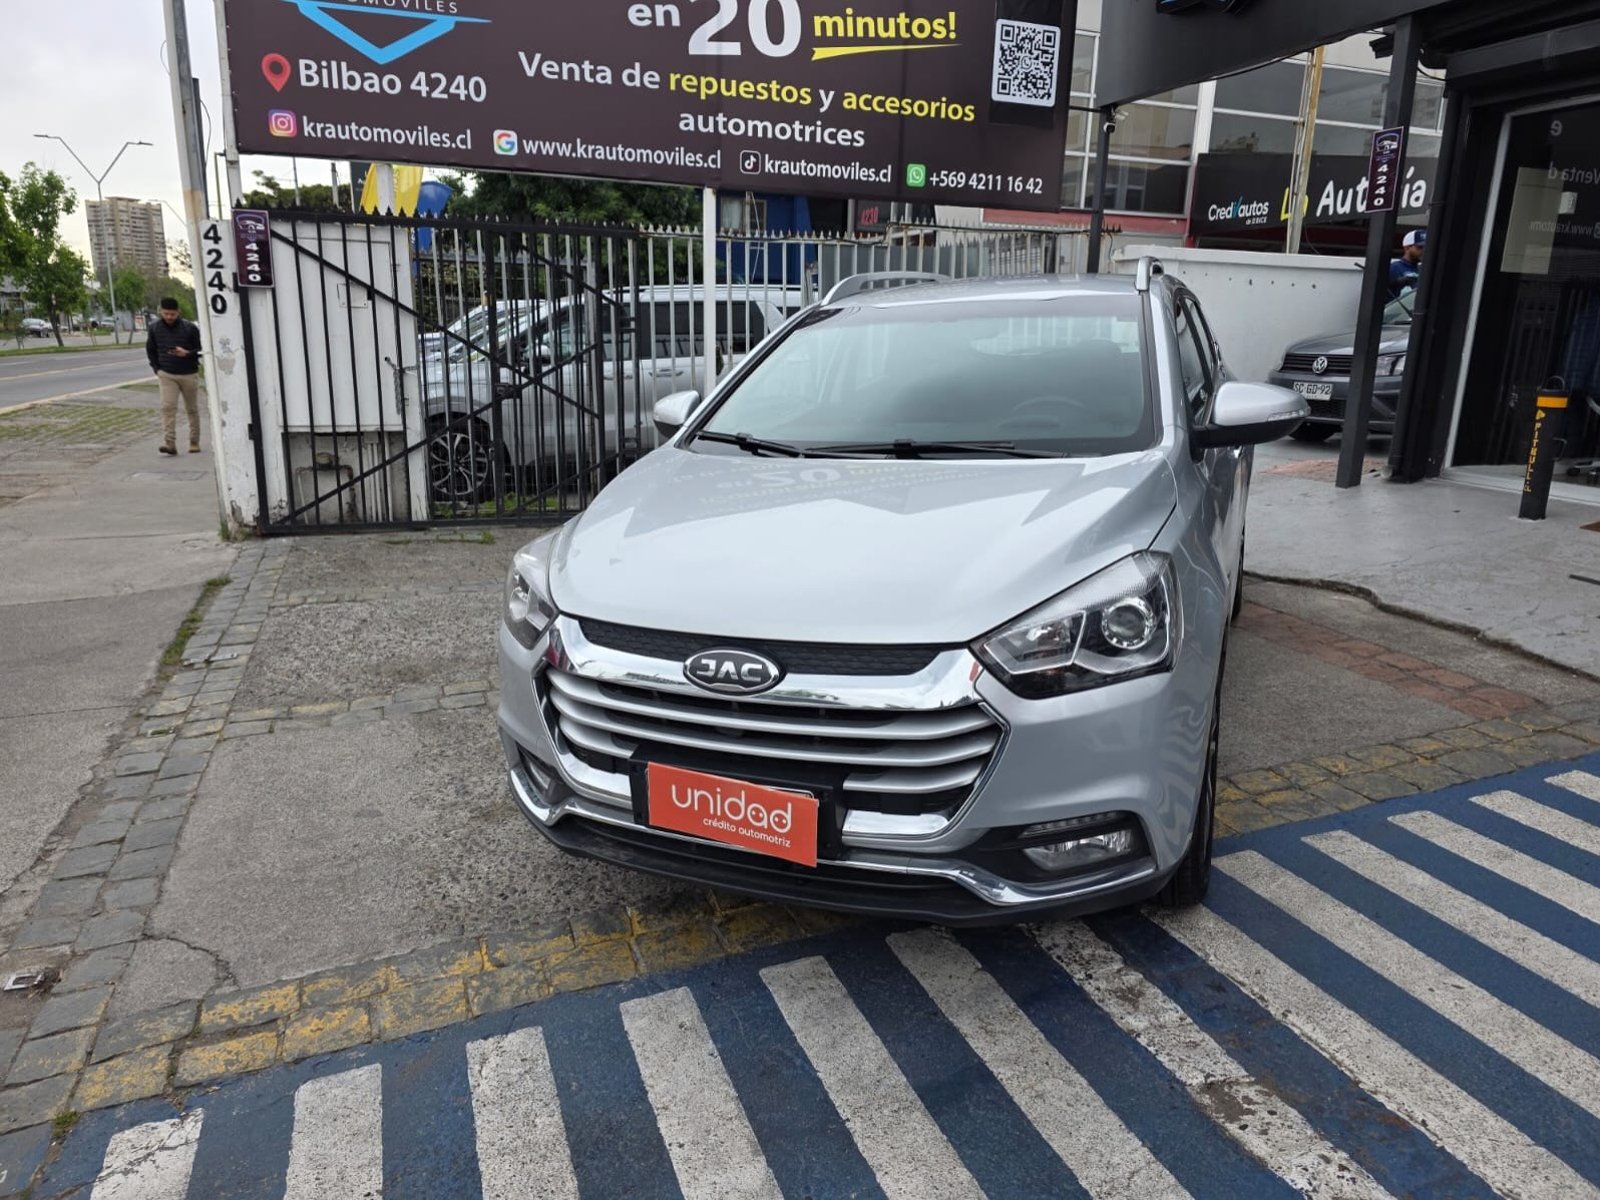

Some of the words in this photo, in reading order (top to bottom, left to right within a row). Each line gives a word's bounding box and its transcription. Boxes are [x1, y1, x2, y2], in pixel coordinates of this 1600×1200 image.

[627, 2, 681, 28] en
[688, 0, 801, 58] 20
[813, 10, 958, 40] minutos!
[299, 58, 401, 95] Bilbao
[409, 70, 487, 103] 4240
[518, 51, 613, 86] Venta
[621, 62, 660, 90] de
[668, 69, 812, 105] repuestos
[818, 86, 835, 113] y
[842, 88, 976, 122] accesorios
[303, 115, 472, 150] krautomoviles.cl
[679, 112, 865, 147] automotrices
[522, 138, 721, 169] www.krautomoviles.cl
[764, 154, 892, 183] krautomoviles.cl
[929, 169, 966, 188] +569
[968, 173, 1002, 191] 4211
[1007, 176, 1023, 193] 16
[1025, 177, 1043, 194] 42
[1316, 165, 1427, 217] Autía
[1373, 164, 1389, 206] 4240
[203, 223, 228, 315] 4240
[245, 242, 262, 282] 4240
[696, 658, 763, 682] JAC
[671, 784, 793, 833] unidad
[702, 816, 737, 832] crédito
[738, 825, 792, 848] automotriz
